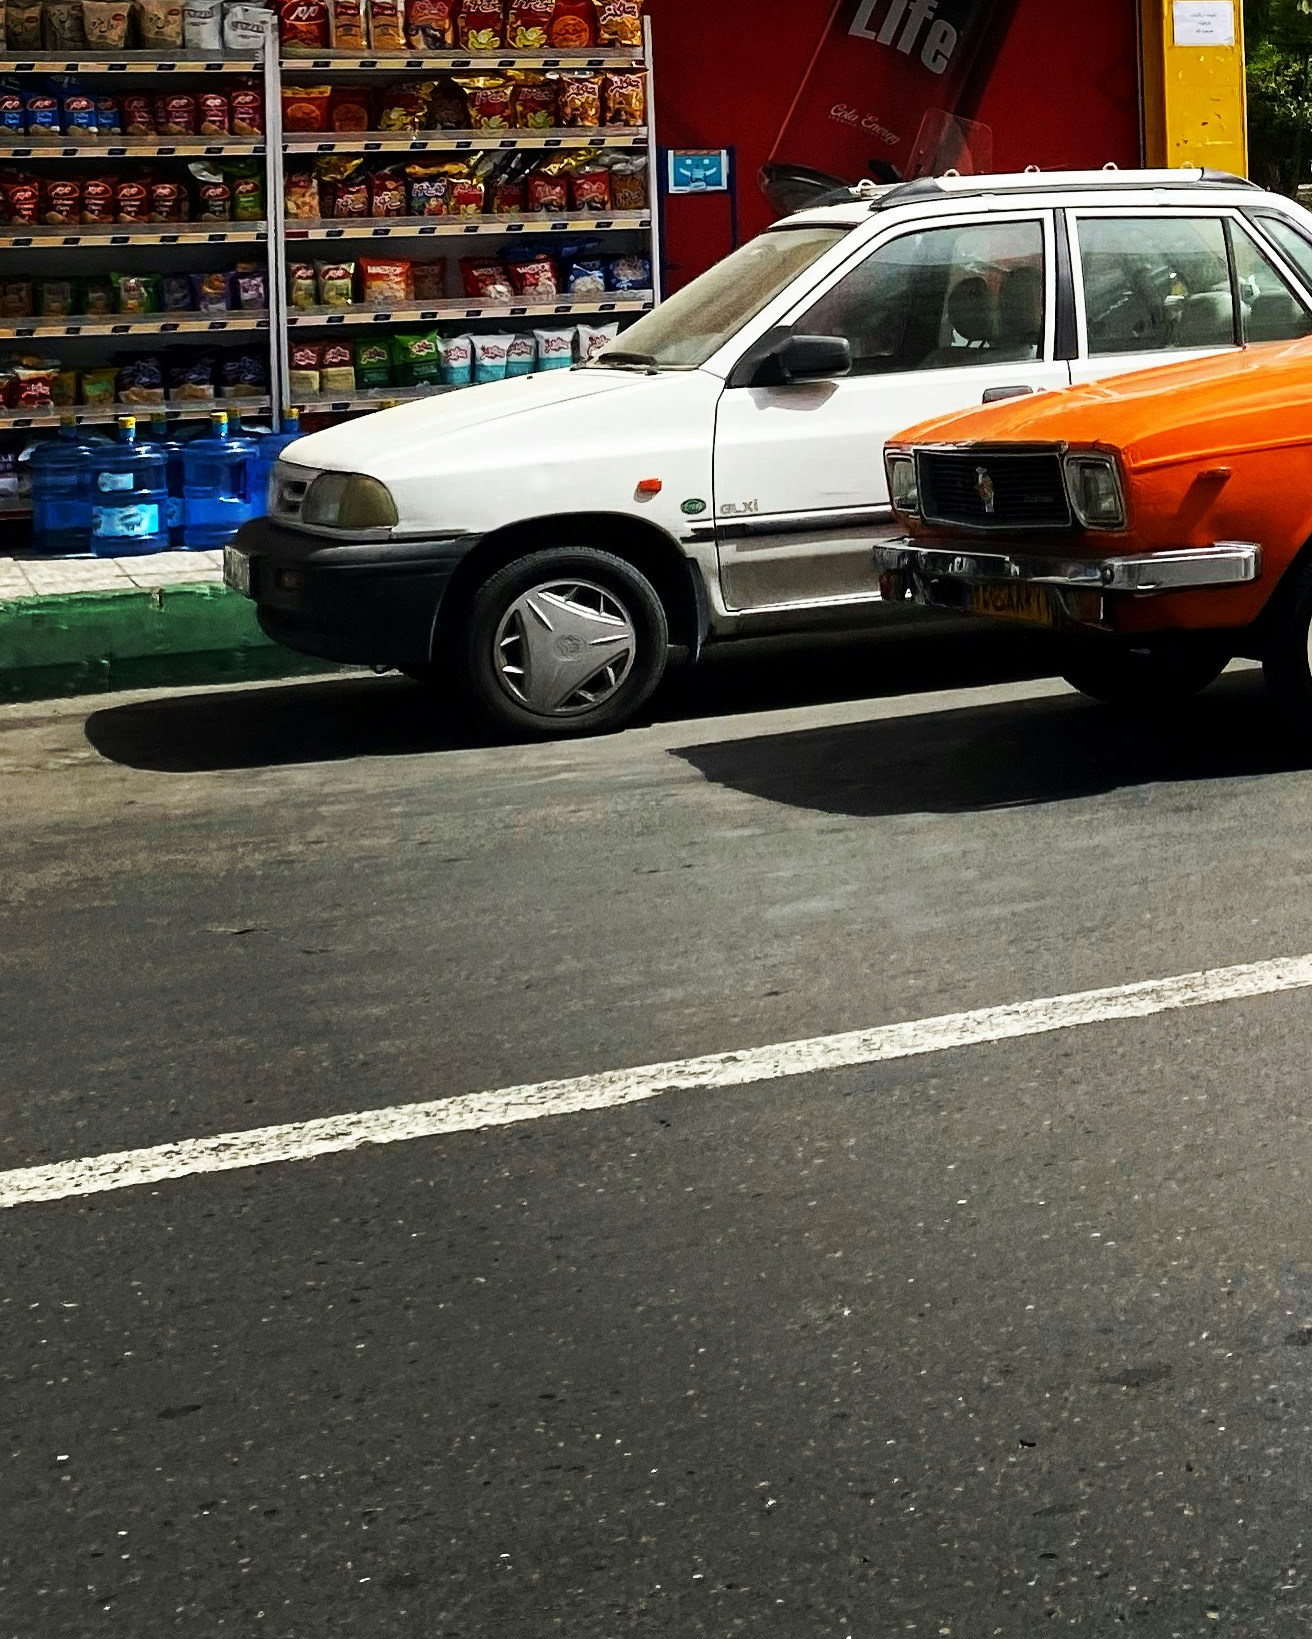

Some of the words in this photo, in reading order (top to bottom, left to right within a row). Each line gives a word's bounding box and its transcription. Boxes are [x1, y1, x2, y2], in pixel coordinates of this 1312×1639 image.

[829, 102, 860, 122] Cola
[861, 111, 900, 146] Energy
[719, 498, 759, 516] GLXi
